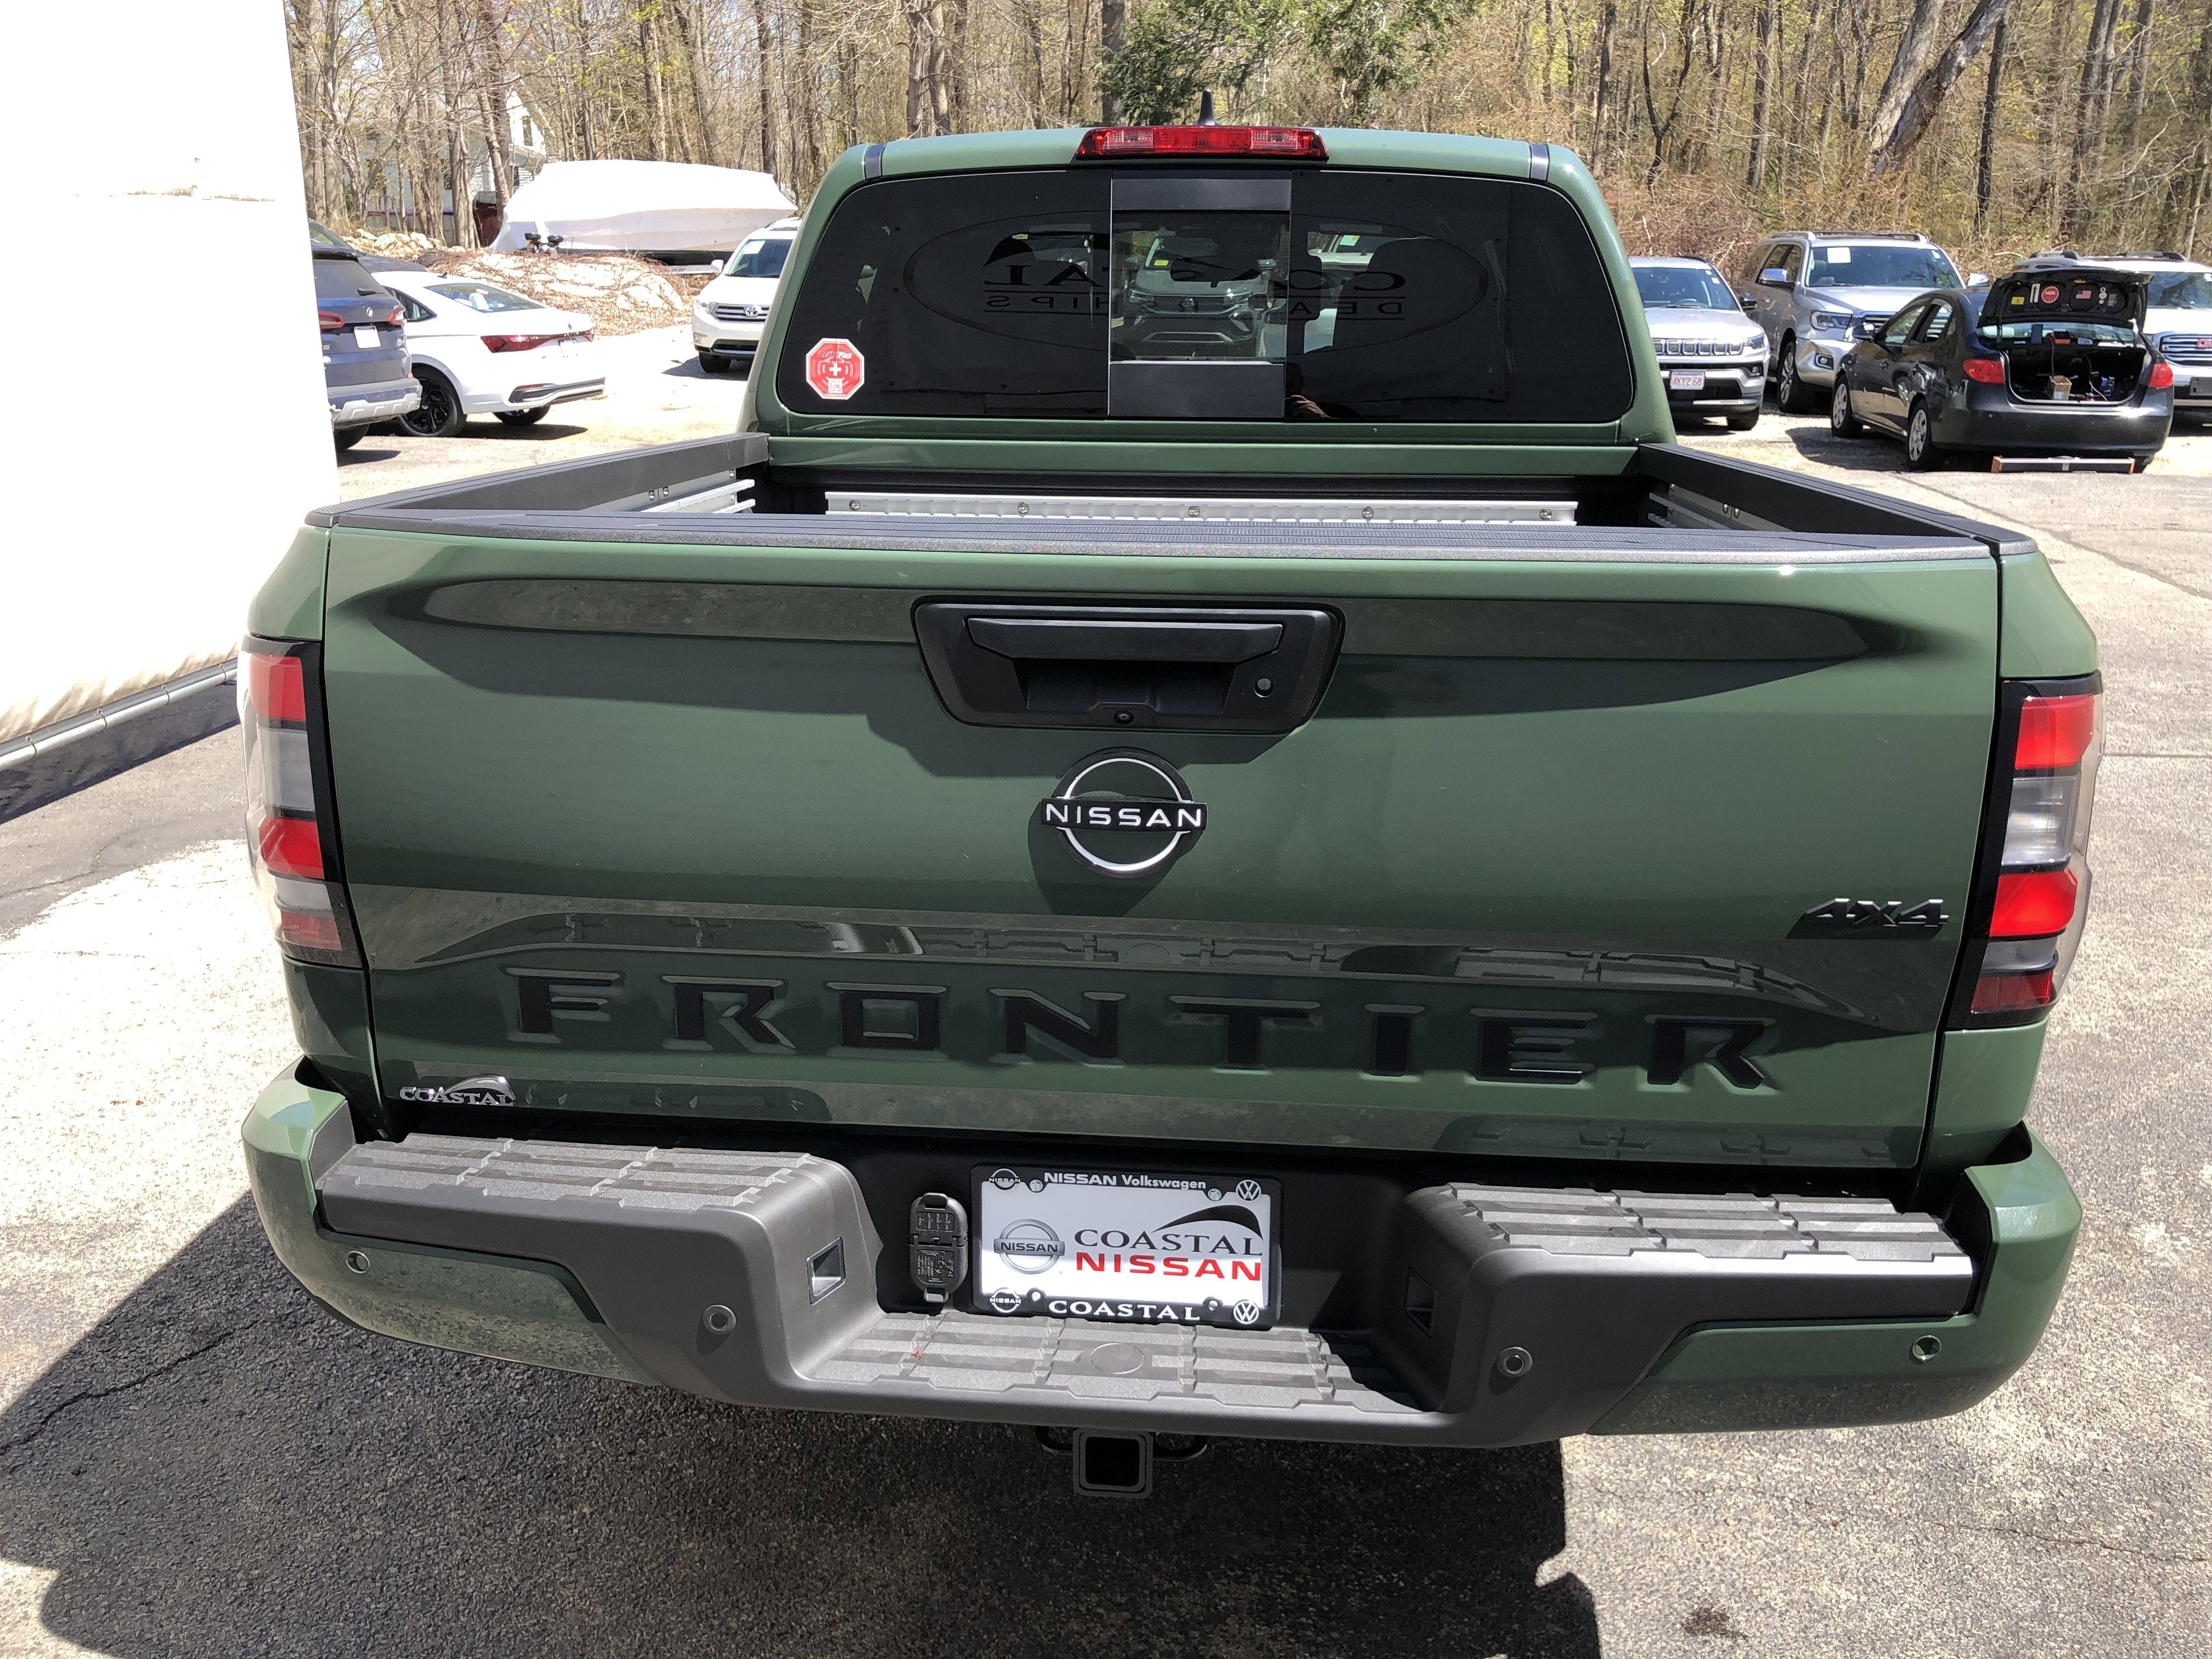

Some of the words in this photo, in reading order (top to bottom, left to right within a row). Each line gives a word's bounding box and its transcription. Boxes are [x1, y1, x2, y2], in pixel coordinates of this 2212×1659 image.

[1046, 803, 1201, 827] NISSAN
[507, 968, 1776, 1093] FRONTIER
[399, 1086, 514, 1107] COASTAL
[1044, 1172, 1116, 1186] NISSAN
[1122, 1174, 1206, 1190] Volkswagen
[1001, 1242, 1058, 1252] NISSAN
[1074, 1229, 1263, 1256] COASTAL
[1076, 1252, 1261, 1281] NISSAN
[1048, 1300, 1200, 1321] COASTAL
